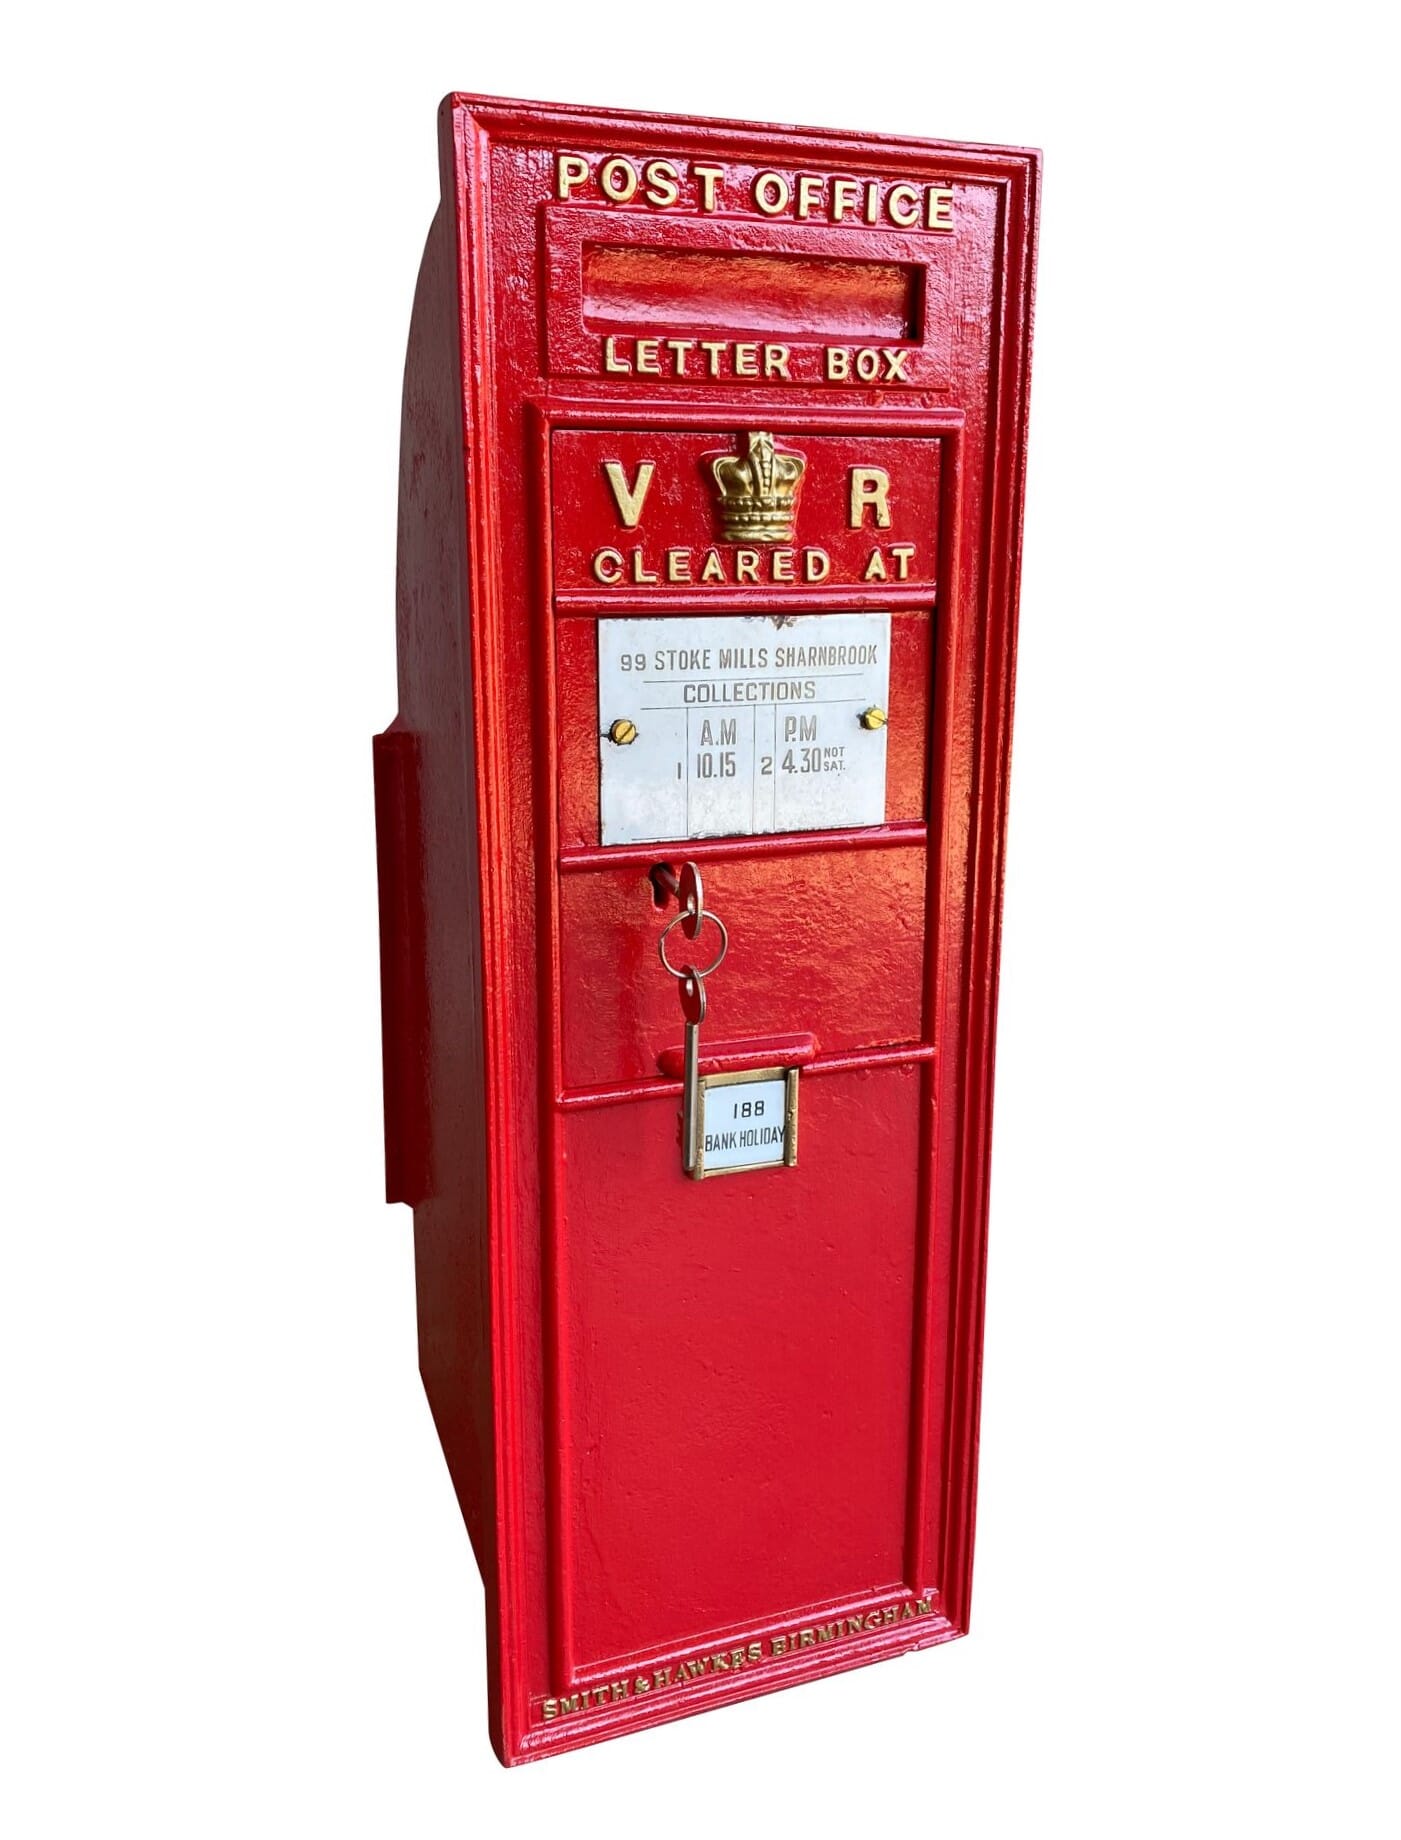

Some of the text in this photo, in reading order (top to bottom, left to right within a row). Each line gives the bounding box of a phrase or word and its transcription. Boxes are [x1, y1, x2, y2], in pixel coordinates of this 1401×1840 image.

[558, 156, 954, 230] POST OFFICE
[605, 337, 909, 381] LETTER BOX
[604, 462, 891, 529] V R
[594, 548, 915, 584] CLEARED AT
[621, 644, 878, 671] 99 STOKE MILLS SHARNBROOK
[683, 681, 816, 703] COLLECTIONS
[700, 715, 817, 746] A.M P.M
[697, 752, 736, 778] 10.15
[761, 756, 773, 775] 2
[782, 748, 821, 774] 4.30
[823, 761, 845, 772] SAT.
[824, 747, 845, 757] NOT
[734, 1100, 764, 1119] 188
[705, 1126, 785, 1152] BANK HOLIDAY
[542, 1597, 932, 1719] SMITH & HAWKES BIRMINGHAM
